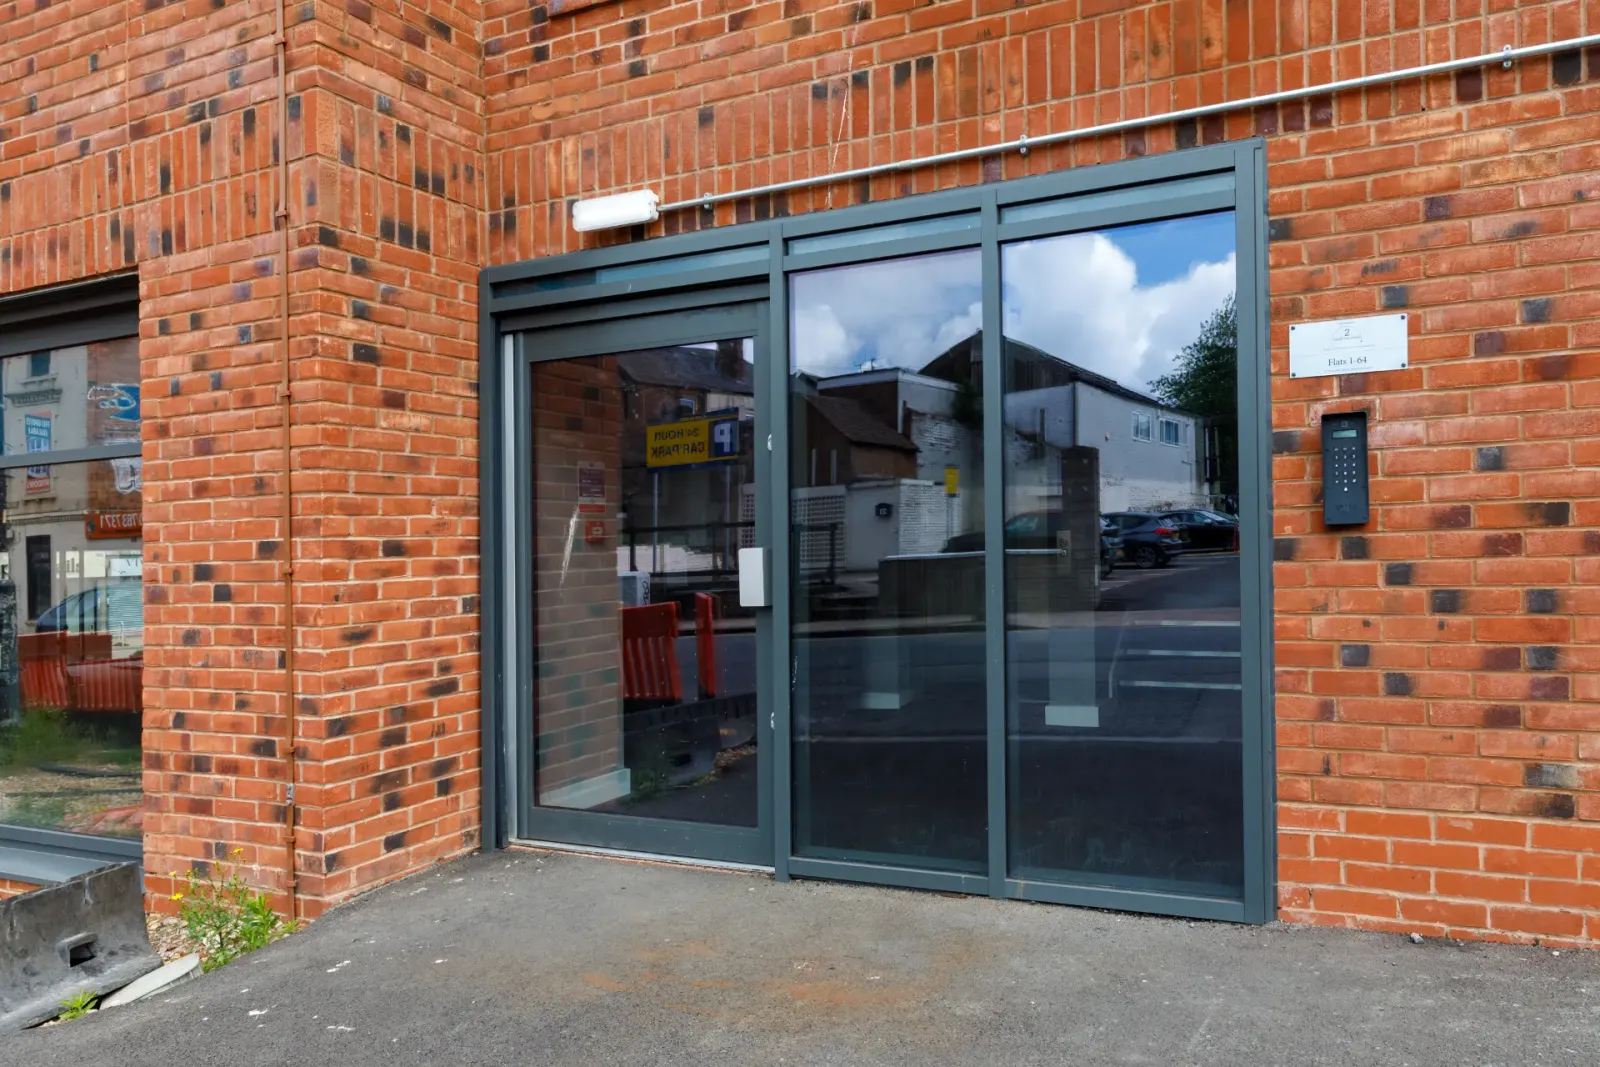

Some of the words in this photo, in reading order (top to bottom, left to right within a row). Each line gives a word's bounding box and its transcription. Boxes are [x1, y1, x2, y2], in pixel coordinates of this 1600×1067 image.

[1344, 328, 1350, 337] 2
[1328, 357, 1347, 367] Flats
[1349, 356, 1367, 366] 1-64
